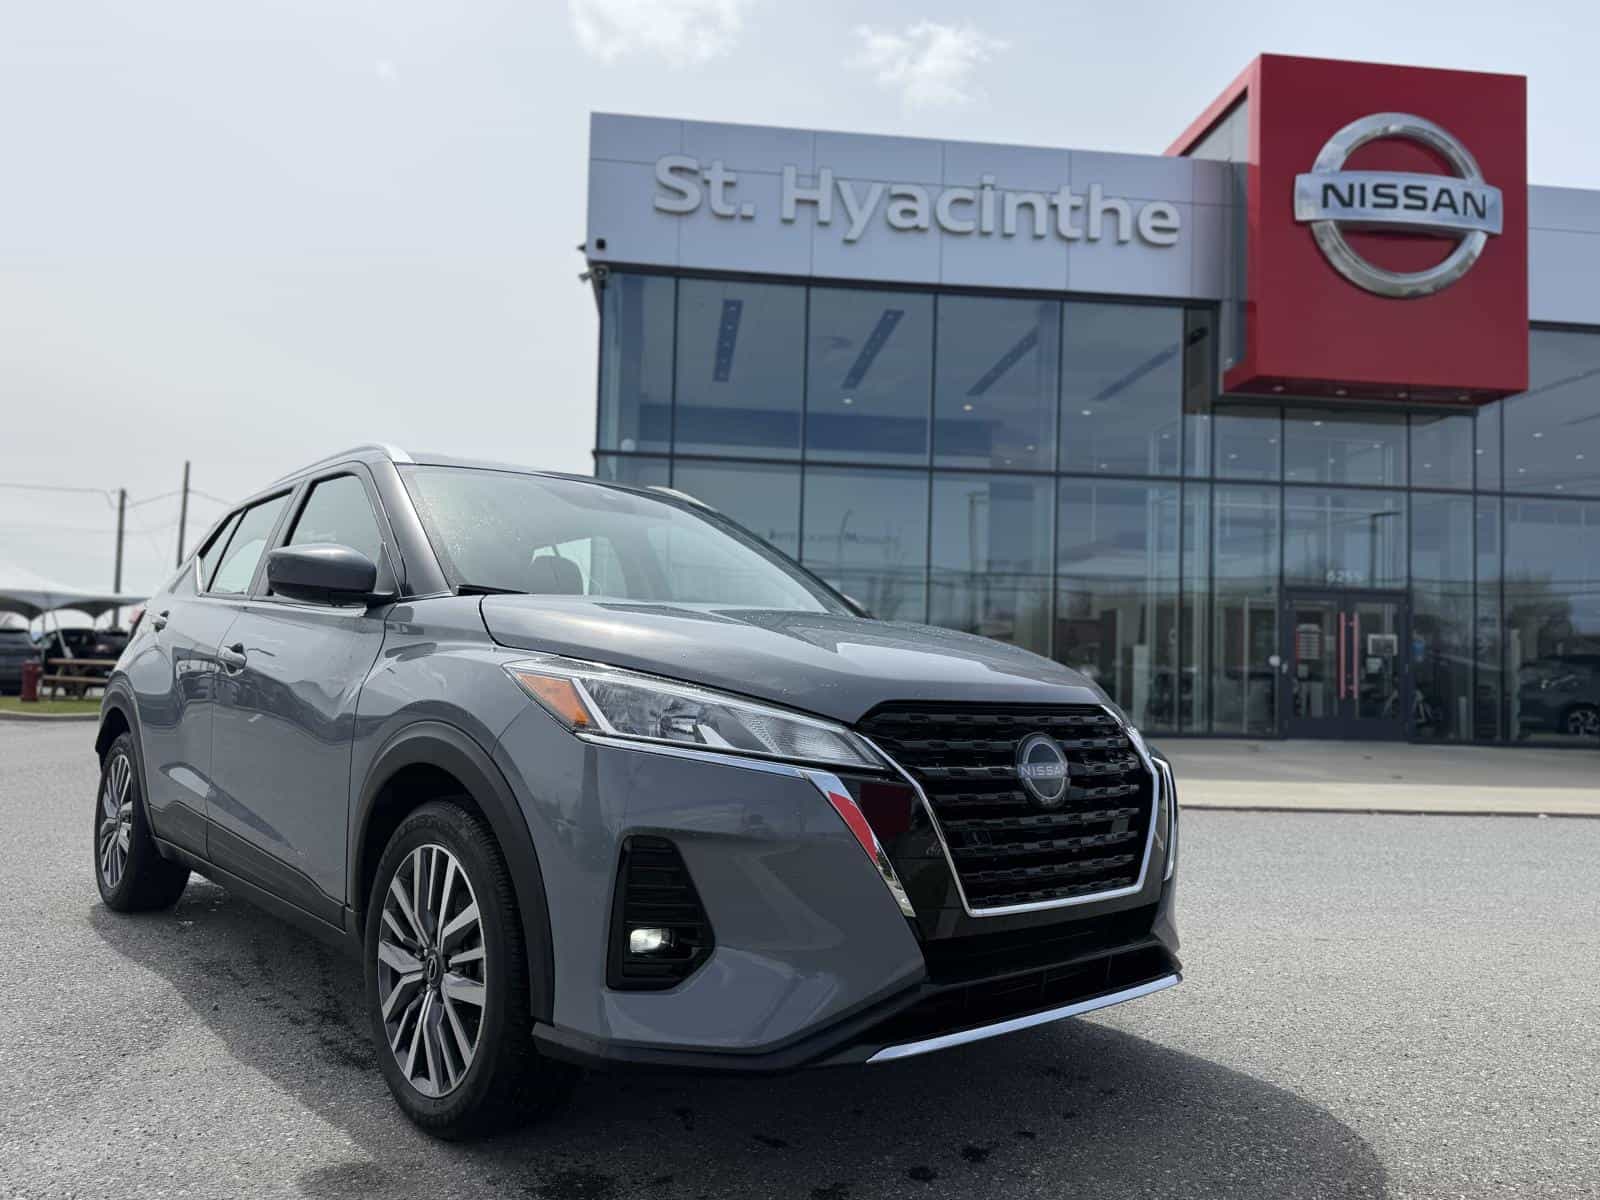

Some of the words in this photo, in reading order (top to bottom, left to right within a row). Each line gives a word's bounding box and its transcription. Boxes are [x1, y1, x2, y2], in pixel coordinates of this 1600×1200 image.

[654, 155, 755, 220] St.
[780, 164, 1181, 248] Hyacinthe
[1321, 183, 1487, 219] NISSAN
